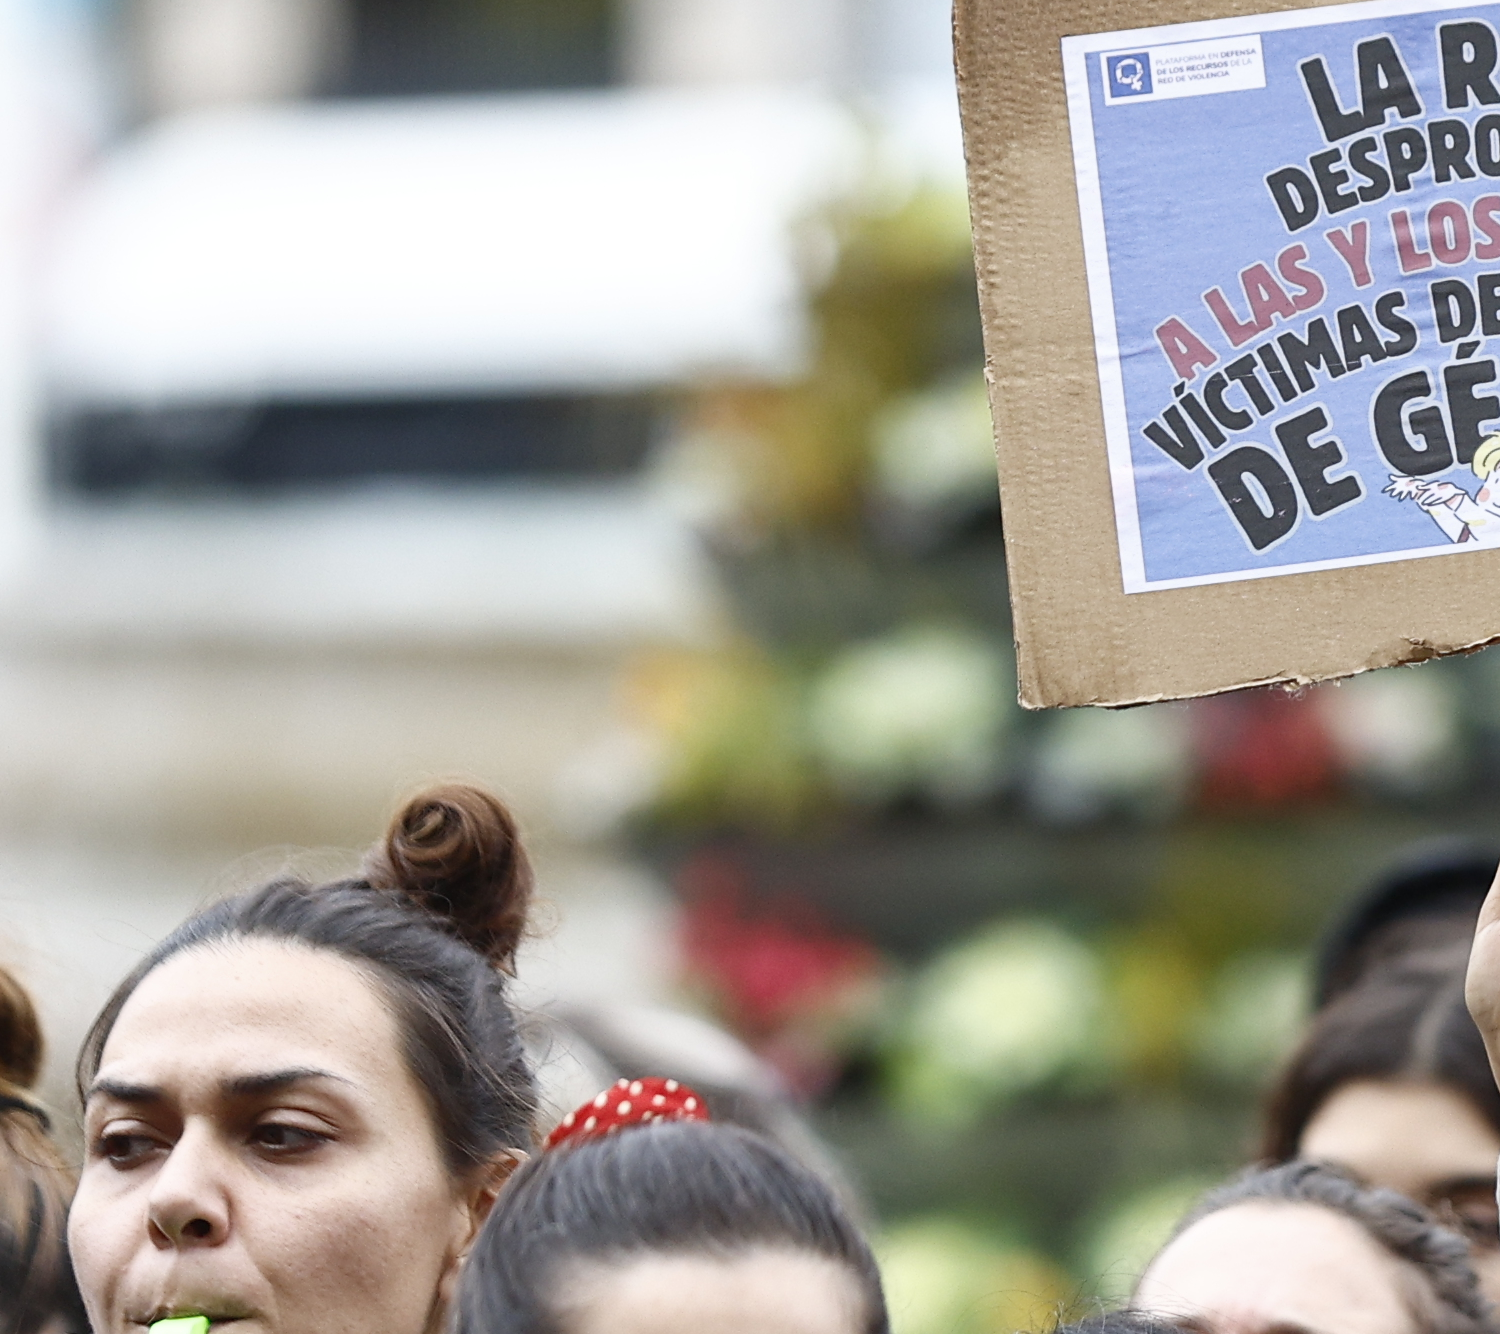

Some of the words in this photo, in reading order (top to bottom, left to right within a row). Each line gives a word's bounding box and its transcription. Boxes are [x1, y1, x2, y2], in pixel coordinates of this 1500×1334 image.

[1155, 54, 1207, 67] PLATAFORMA
[1208, 52, 1219, 60] EN
[1220, 48, 1257, 59] DEFENSA
[1156, 67, 1167, 76] DE
[1168, 66, 1184, 75] LOS
[1185, 60, 1229, 72] RECURSOS
[1230, 59, 1241, 68] DE
[1242, 57, 1253, 66] LA
[1157, 76, 1174, 85] RED
[1175, 74, 1186, 83] DE
[1187, 69, 1231, 82] VIOLENCIA
[1300, 37, 1422, 143] LA
[1156, 315, 1217, 380] A
[1204, 242, 1324, 347] LAS
[1329, 223, 1370, 287] Y
[1143, 291, 1417, 471] VÍCTIMAS
[1207, 407, 1362, 550] DE
